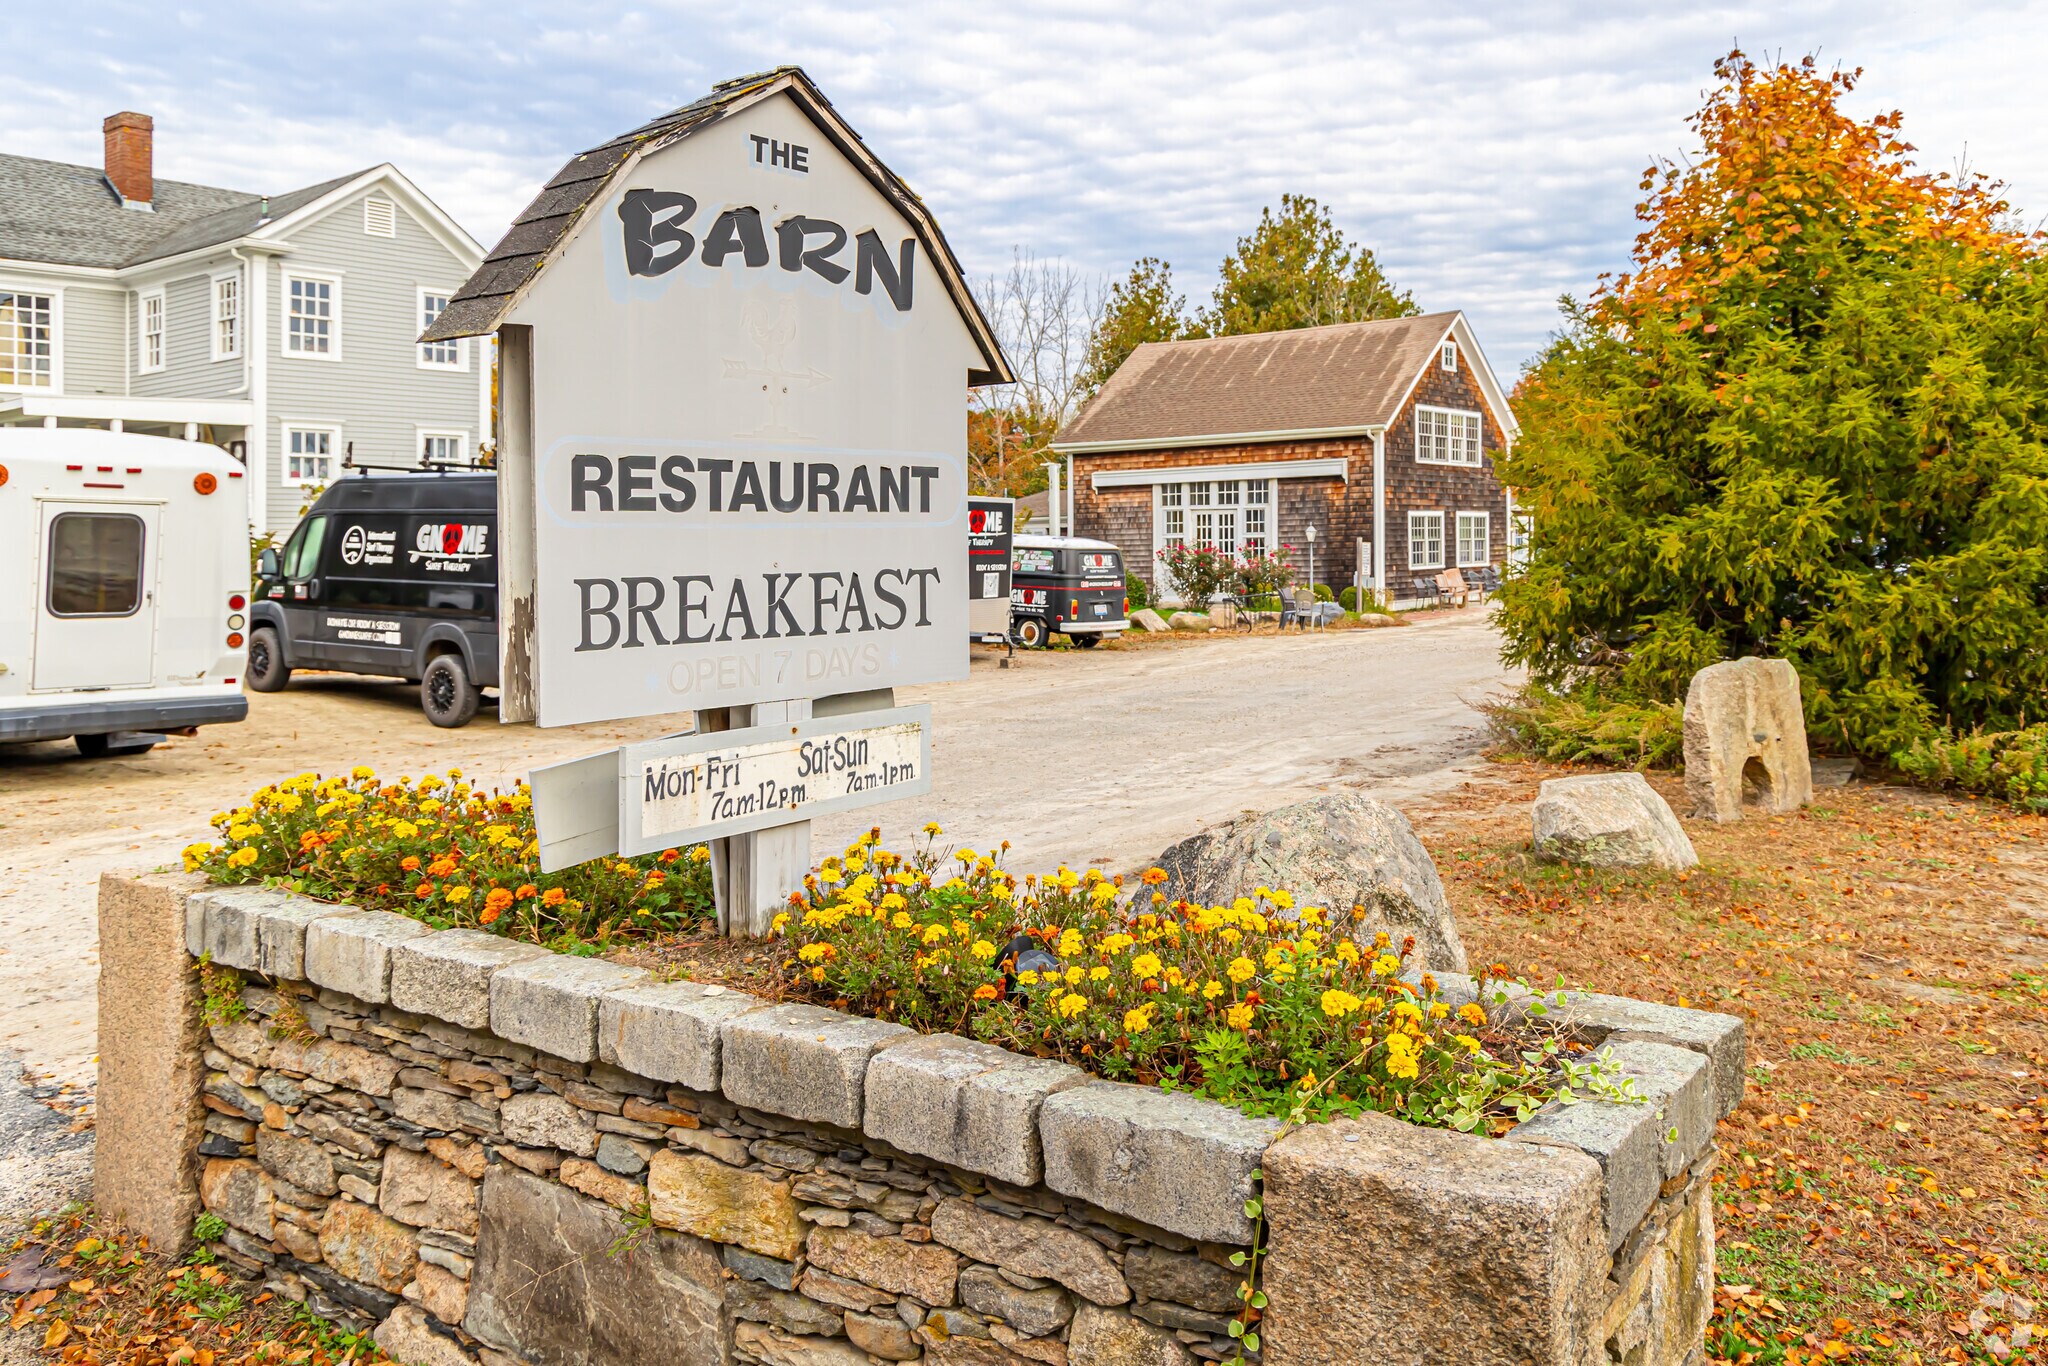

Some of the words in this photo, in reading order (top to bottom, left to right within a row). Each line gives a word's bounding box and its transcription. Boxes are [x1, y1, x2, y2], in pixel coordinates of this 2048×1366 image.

[750, 134, 809, 174] THE
[618, 188, 916, 312] BARN
[571, 453, 940, 513] RESTAURANT
[416, 523, 488, 556] GNOME
[573, 566, 941, 653] BREAKFAST
[1011, 588, 1047, 605] GNOME
[667, 652, 761, 695] OPEN
[773, 650, 793, 684] 7
[805, 642, 881, 682] DAYS
